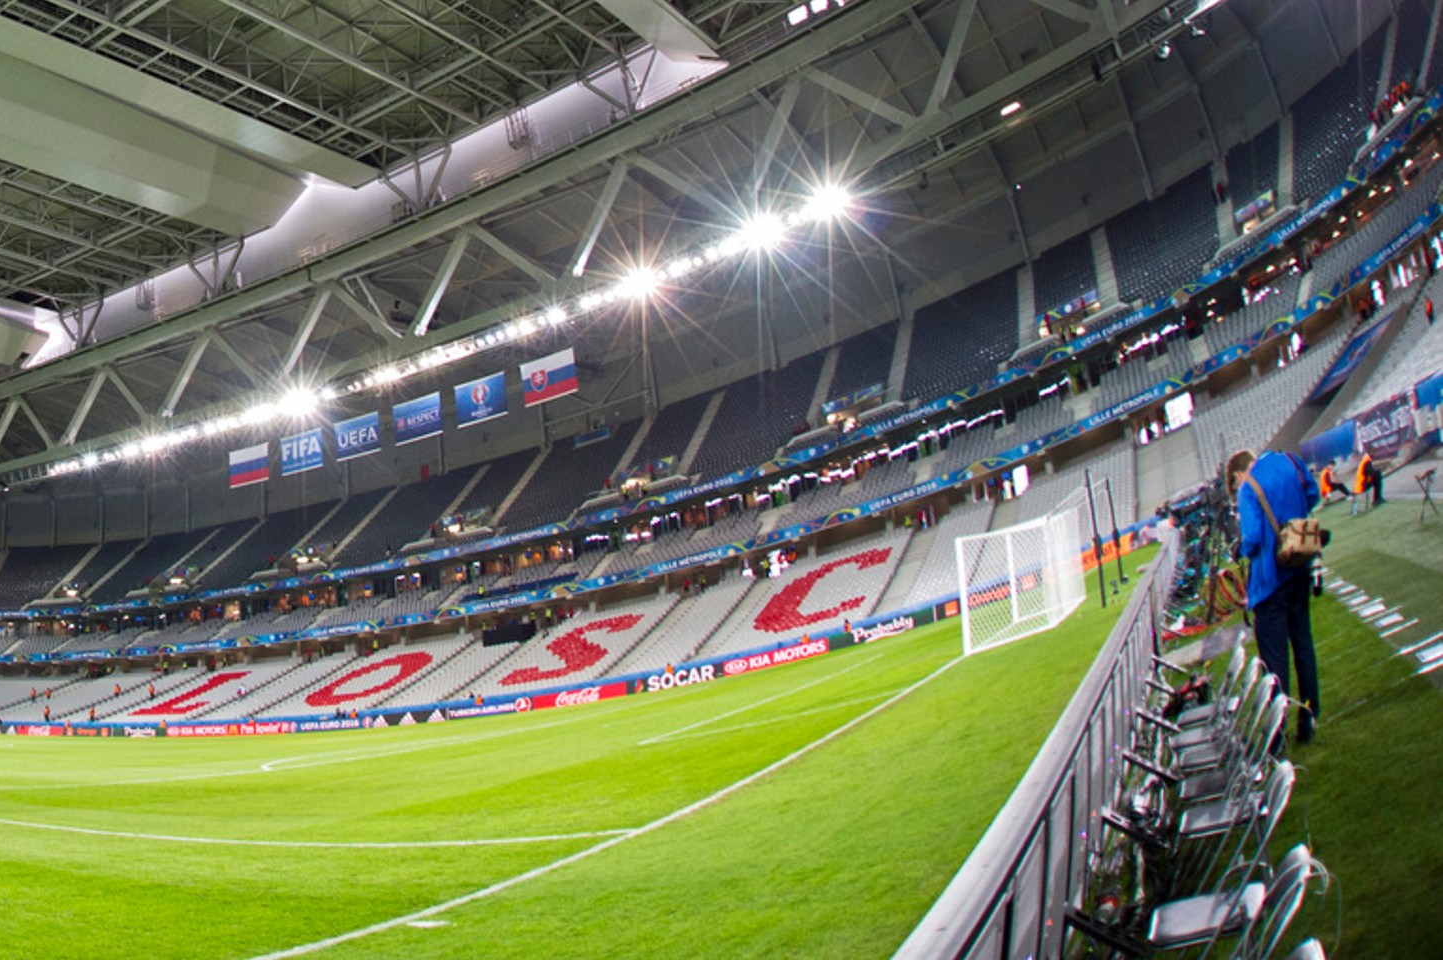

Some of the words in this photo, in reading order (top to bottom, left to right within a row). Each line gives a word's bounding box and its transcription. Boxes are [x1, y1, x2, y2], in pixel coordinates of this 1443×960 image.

[1277, 224, 1296, 240] LILLE
[1080, 332, 1102, 347] UEFA
[1102, 320, 1124, 337] EURO
[872, 420, 893, 434] LILLE
[1089, 410, 1112, 426] LILLE
[337, 426, 378, 449] UEFA
[282, 436, 321, 461] FIFA
[673, 488, 693, 501] UEFA
[693, 482, 714, 494] EURO
[869, 496, 892, 510] UEFA
[892, 489, 915, 503] EURO
[916, 481, 938, 495] 2016
[658, 560, 678, 572] LILLE
[472, 602, 490, 612] UEFA
[490, 599, 510, 609] EURO
[851, 616, 914, 643] Probably
[749, 655, 771, 669] KIA
[773, 640, 827, 664] MOTORS
[647, 664, 715, 693] SOCAR
[555, 686, 601, 709] Coca-Cola
[181, 727, 193, 735] KIA
[194, 725, 227, 734] MOTORS
[300, 721, 320, 731] UEFA
[320, 720, 340, 730] EURO
[340, 719, 360, 728] 2016
